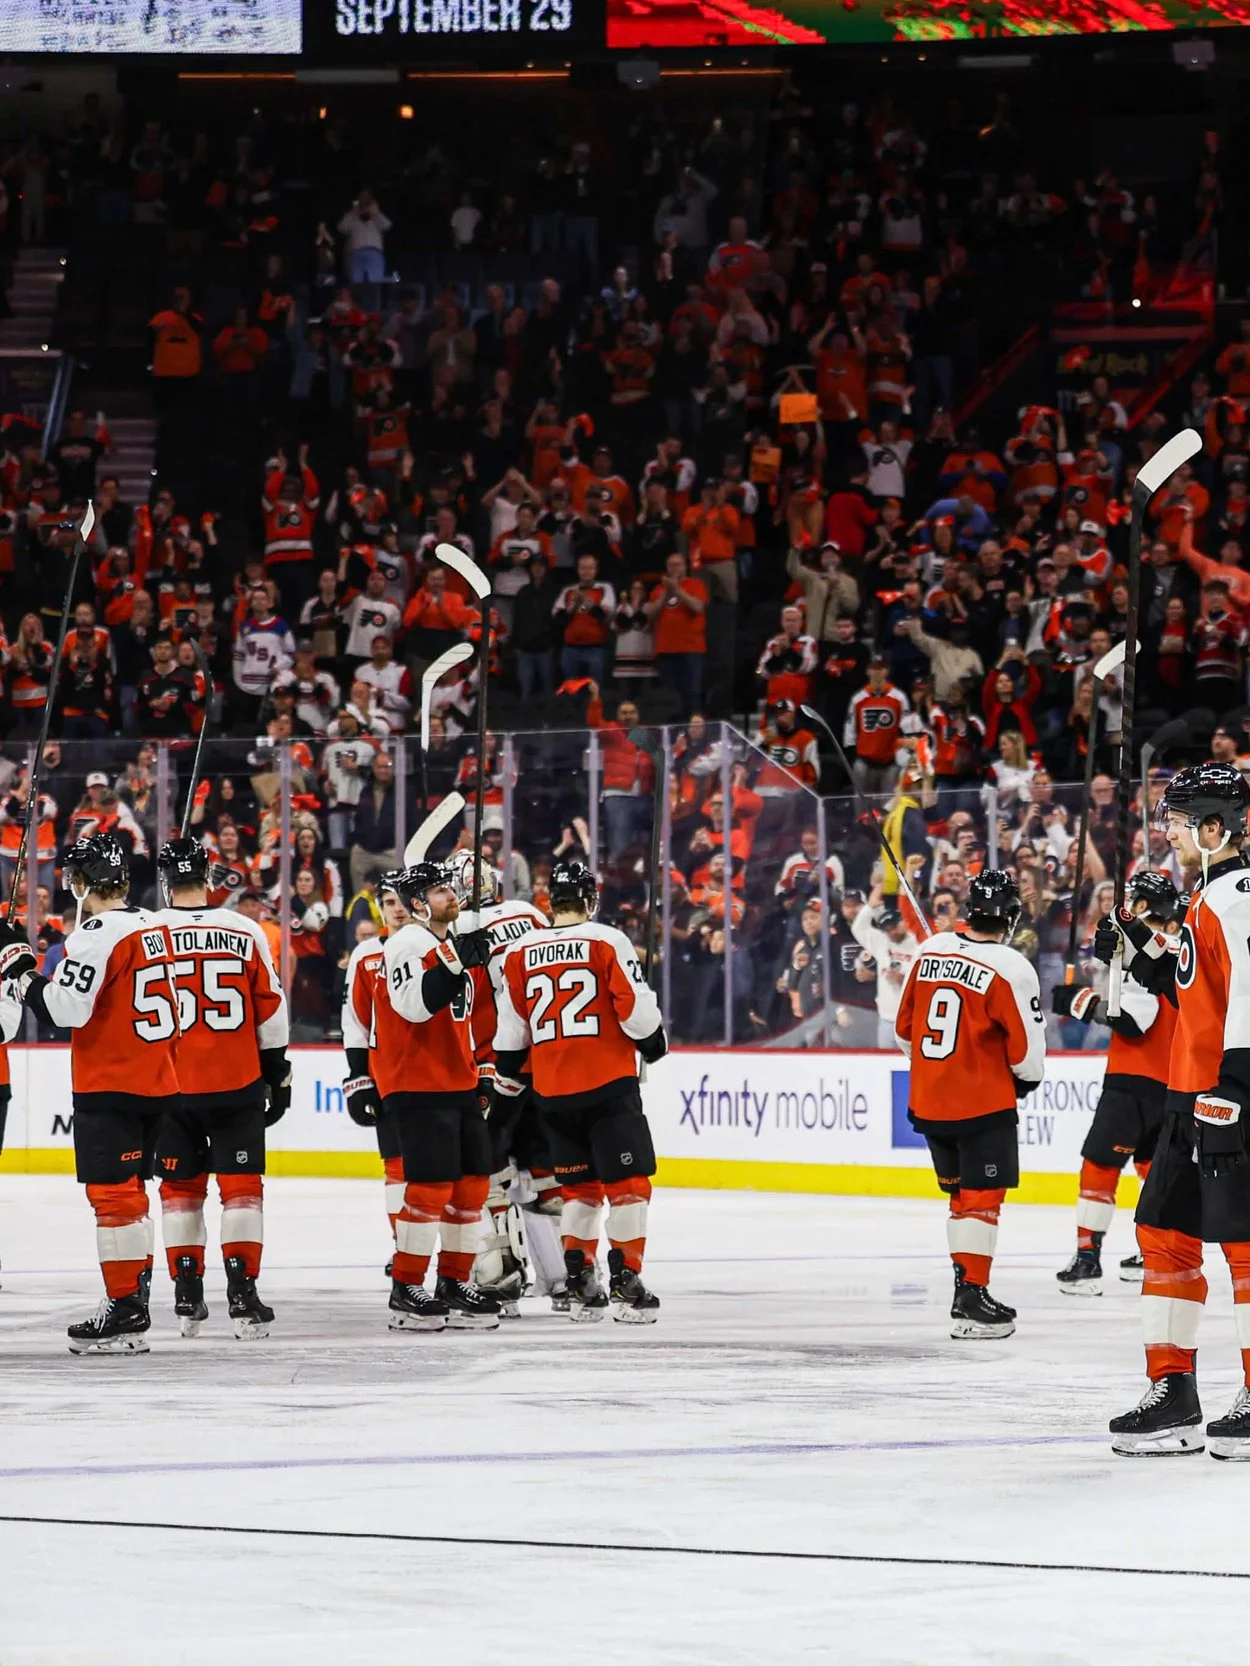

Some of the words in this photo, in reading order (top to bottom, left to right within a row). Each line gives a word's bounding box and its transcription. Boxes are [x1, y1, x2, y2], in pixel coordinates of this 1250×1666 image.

[336, 0, 521, 35] SEPTEMBER
[529, 0, 572, 31] 29
[110, 854, 122, 866] 59
[178, 861, 192, 873] 55
[984, 888, 993, 899] 9
[529, 942, 584, 967] DVORAK
[59, 959, 97, 995] 59
[392, 961, 413, 990] 91
[920, 958, 989, 990] DRYSDALE
[526, 967, 600, 1045] 22
[1030, 996, 1043, 1024] 9
[921, 986, 963, 1060] 9
[680, 1074, 769, 1137] xfinity
[776, 1078, 869, 1131] mobile
